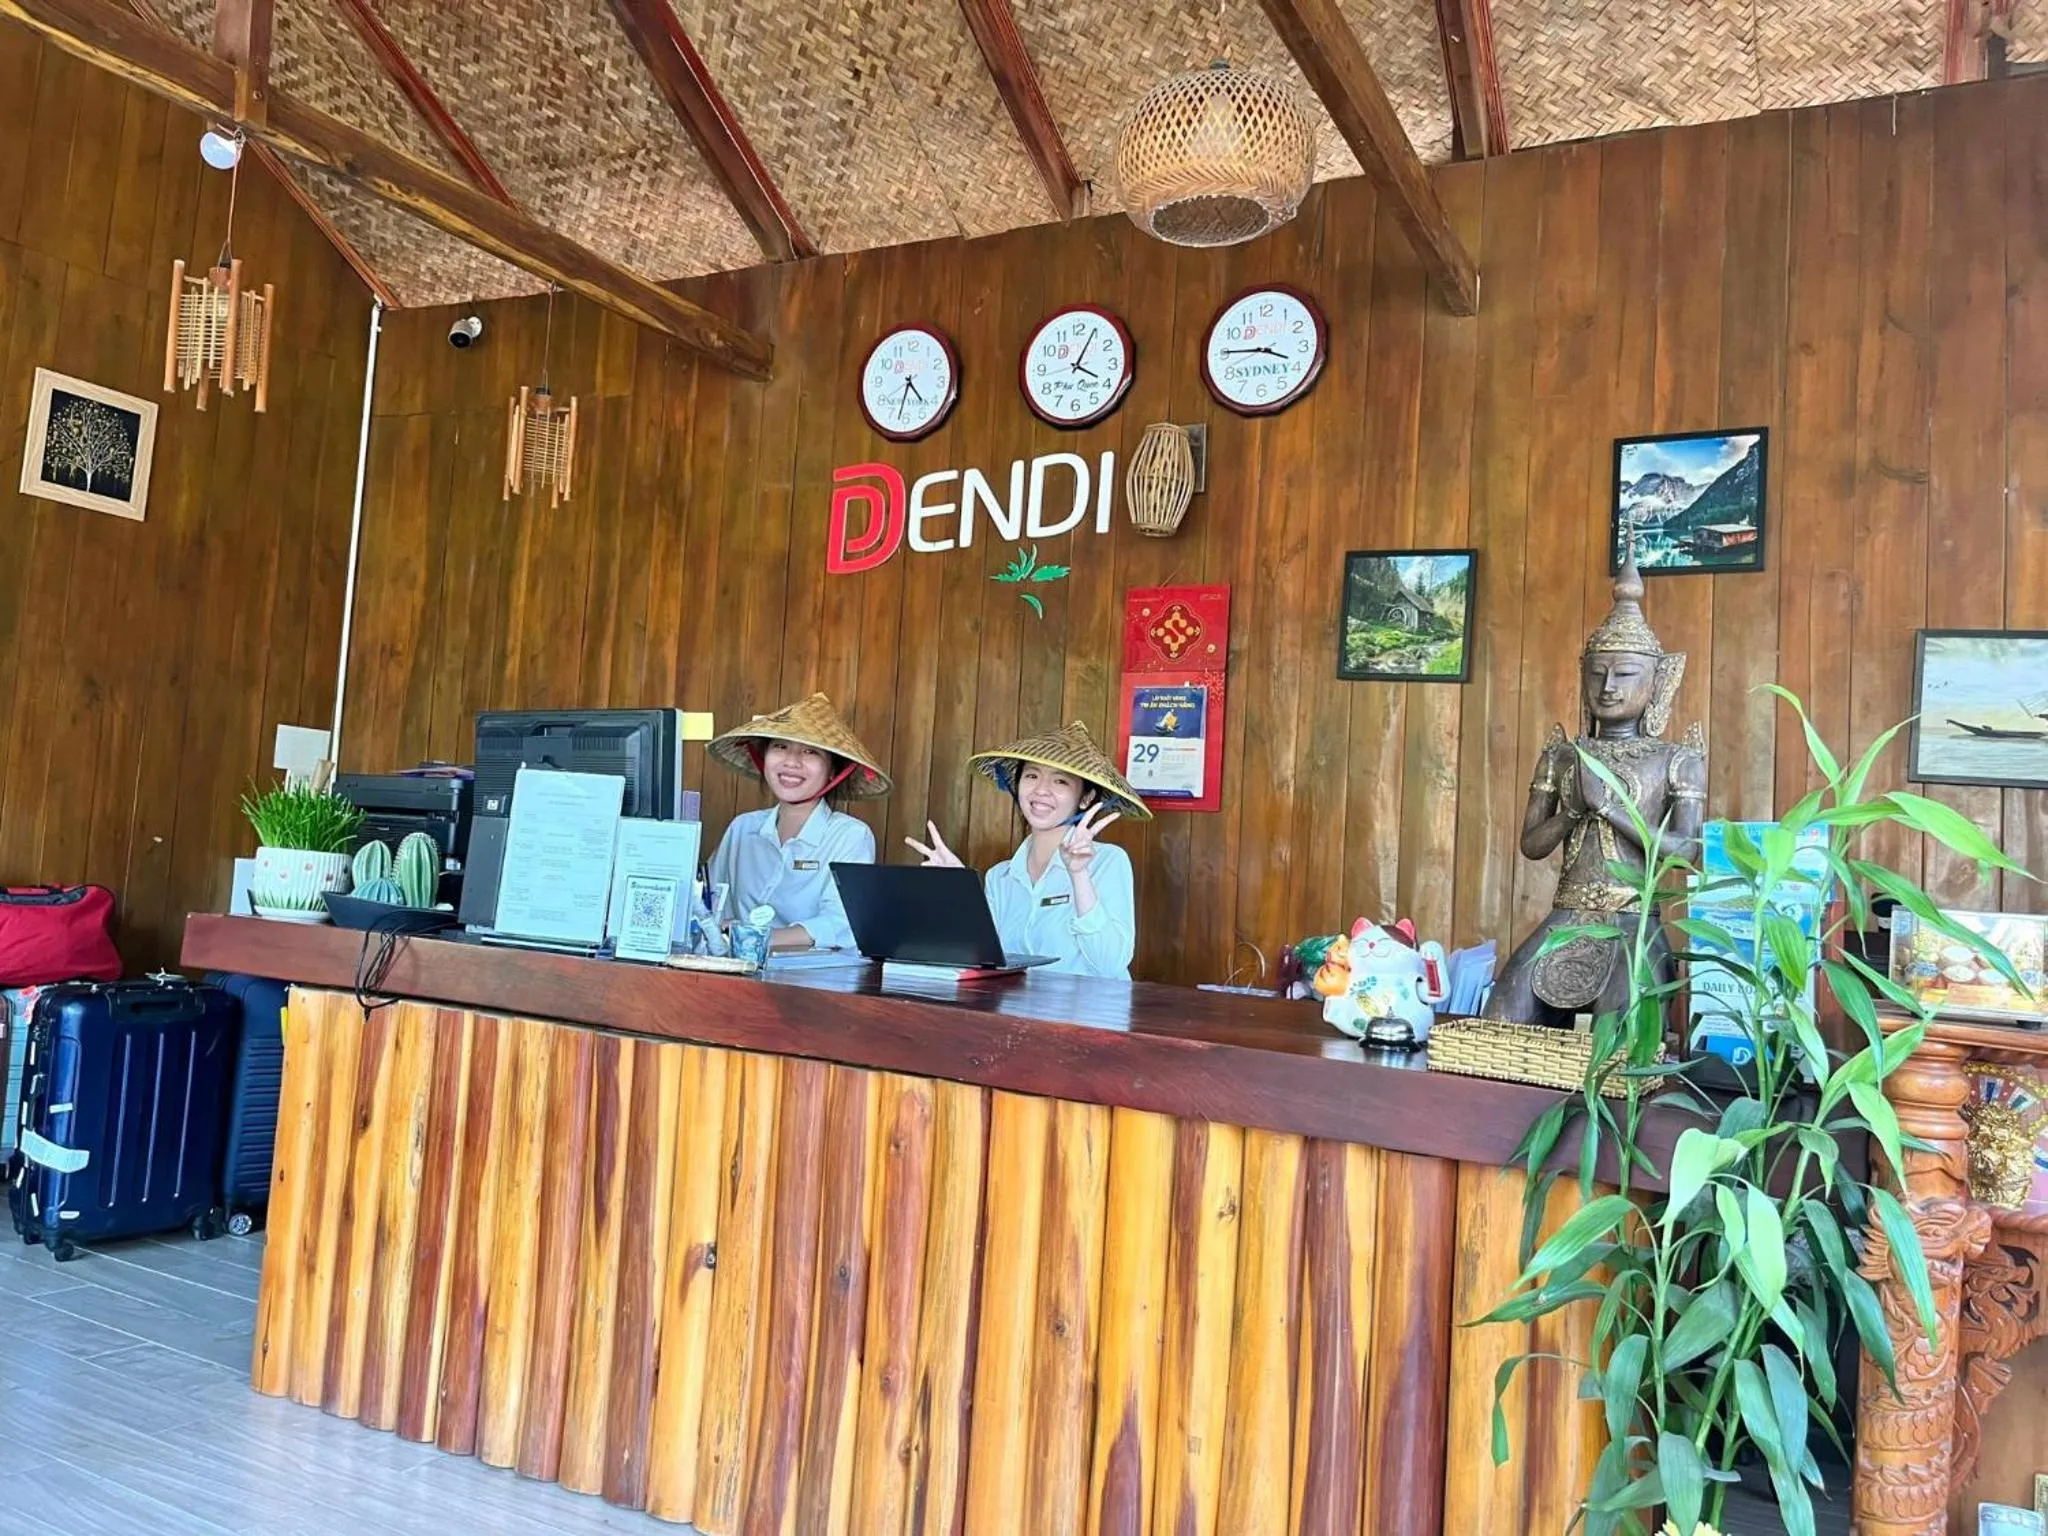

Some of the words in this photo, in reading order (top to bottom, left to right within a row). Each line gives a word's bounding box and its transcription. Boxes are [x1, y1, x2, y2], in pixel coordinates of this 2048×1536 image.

[1260, 304, 1273, 317] 12
[1243, 312, 1252, 325] 11
[1073, 324, 1085, 336] 12
[1293, 321, 1304, 333] 2
[1057, 330, 1066, 342] 11
[1227, 327, 1240, 340] 10
[908, 340, 919, 352] 12
[1043, 345, 1056, 357] 10
[1102, 339, 1112, 351] 2
[1297, 340, 1308, 353] 3
[894, 346, 902, 358] 11
[881, 359, 892, 369] 10
[933, 359, 942, 370] 2
[1037, 364, 1046, 376] 9
[1108, 358, 1118, 370] 3
[1292, 361, 1301, 373] 4
[1225, 367, 1234, 380] 8
[1236, 364, 1289, 377] SYDNEY
[875, 376, 883, 387] 9
[937, 376, 945, 388] 3
[1102, 378, 1111, 389] 4
[1238, 380, 1247, 393] 7
[1277, 376, 1287, 389] 5
[1041, 382, 1051, 395] 8
[1256, 384, 1266, 397] 6
[878, 394, 887, 406] 8
[1055, 395, 1063, 407] 7
[1089, 392, 1099, 404] 5
[1071, 399, 1080, 411] 6
[903, 412, 910, 425] 6
[918, 408, 926, 419] 5
[827, 451, 1115, 574] DENDI
[1133, 743, 1159, 763] 29
[1703, 981, 1735, 993] DAILY
